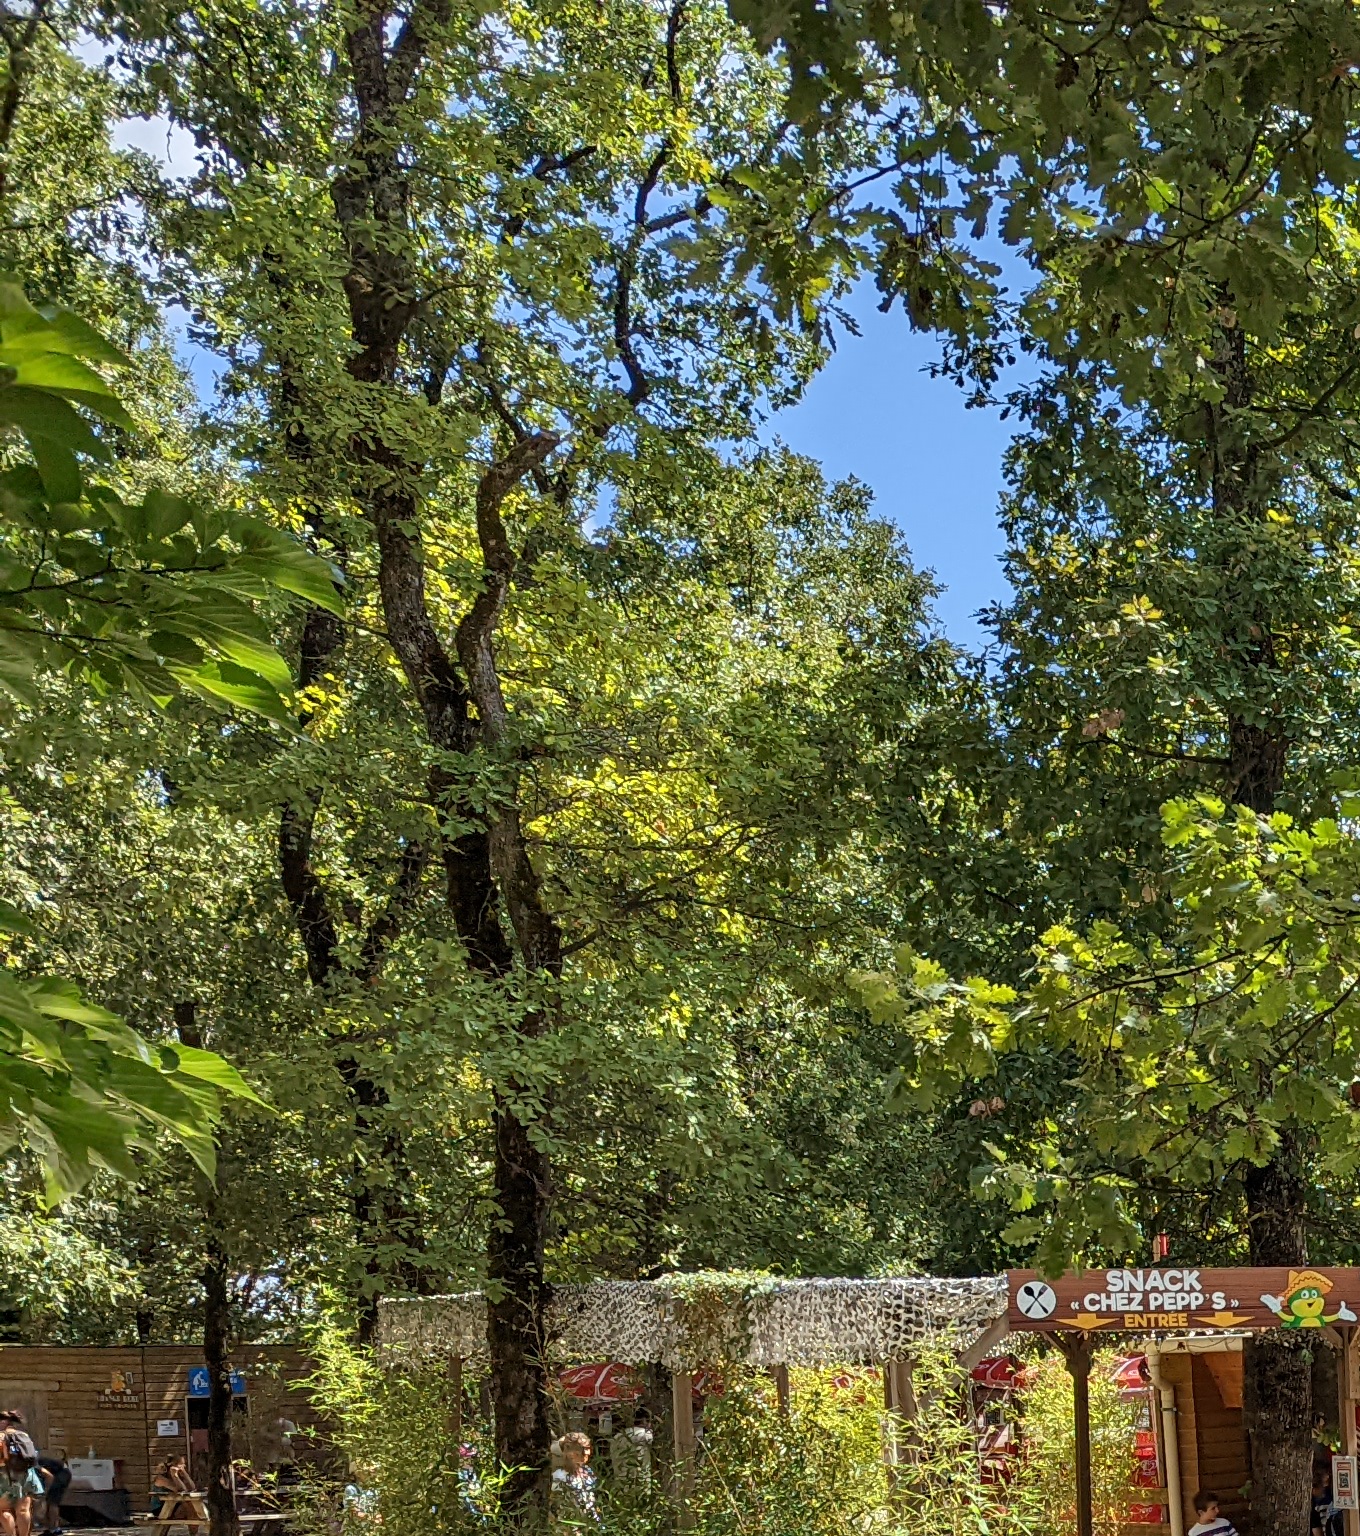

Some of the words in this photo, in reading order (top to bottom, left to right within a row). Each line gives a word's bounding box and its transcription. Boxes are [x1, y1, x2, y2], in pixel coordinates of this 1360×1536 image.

[1106, 1269, 1203, 1292] SNACK
[1083, 1292, 1143, 1311] CHEZ
[1124, 1312, 1189, 1328] ENTRÉE
